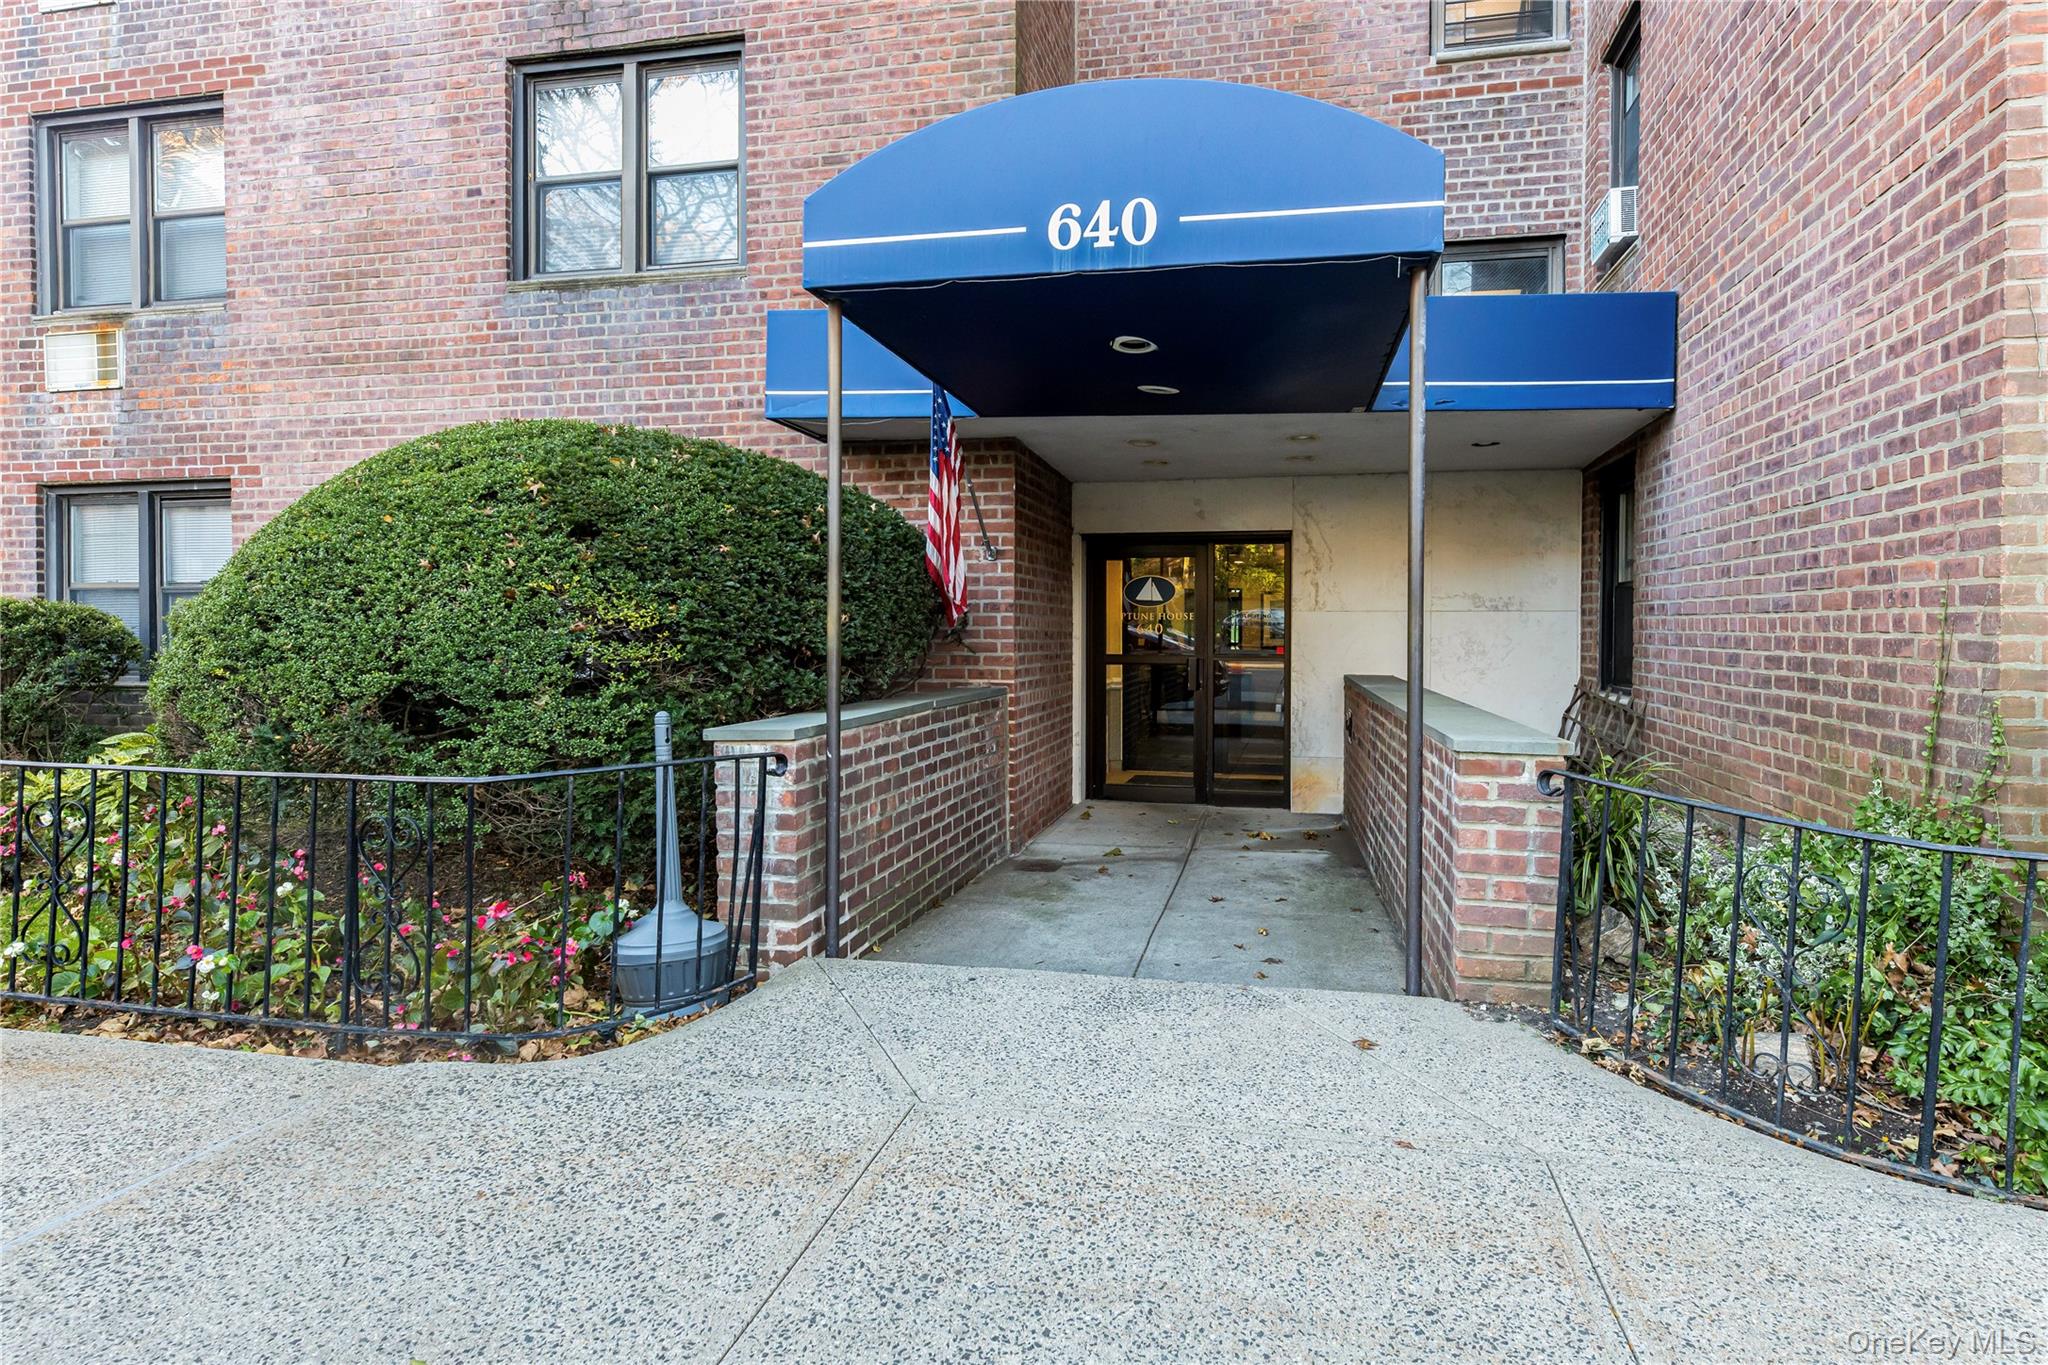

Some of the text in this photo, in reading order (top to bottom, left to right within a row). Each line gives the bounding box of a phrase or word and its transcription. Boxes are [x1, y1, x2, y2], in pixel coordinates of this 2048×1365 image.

[1047, 197, 1158, 251] 640
[1121, 612, 1195, 621] PTUNE HOUSE
[1136, 623, 1164, 635] 640
